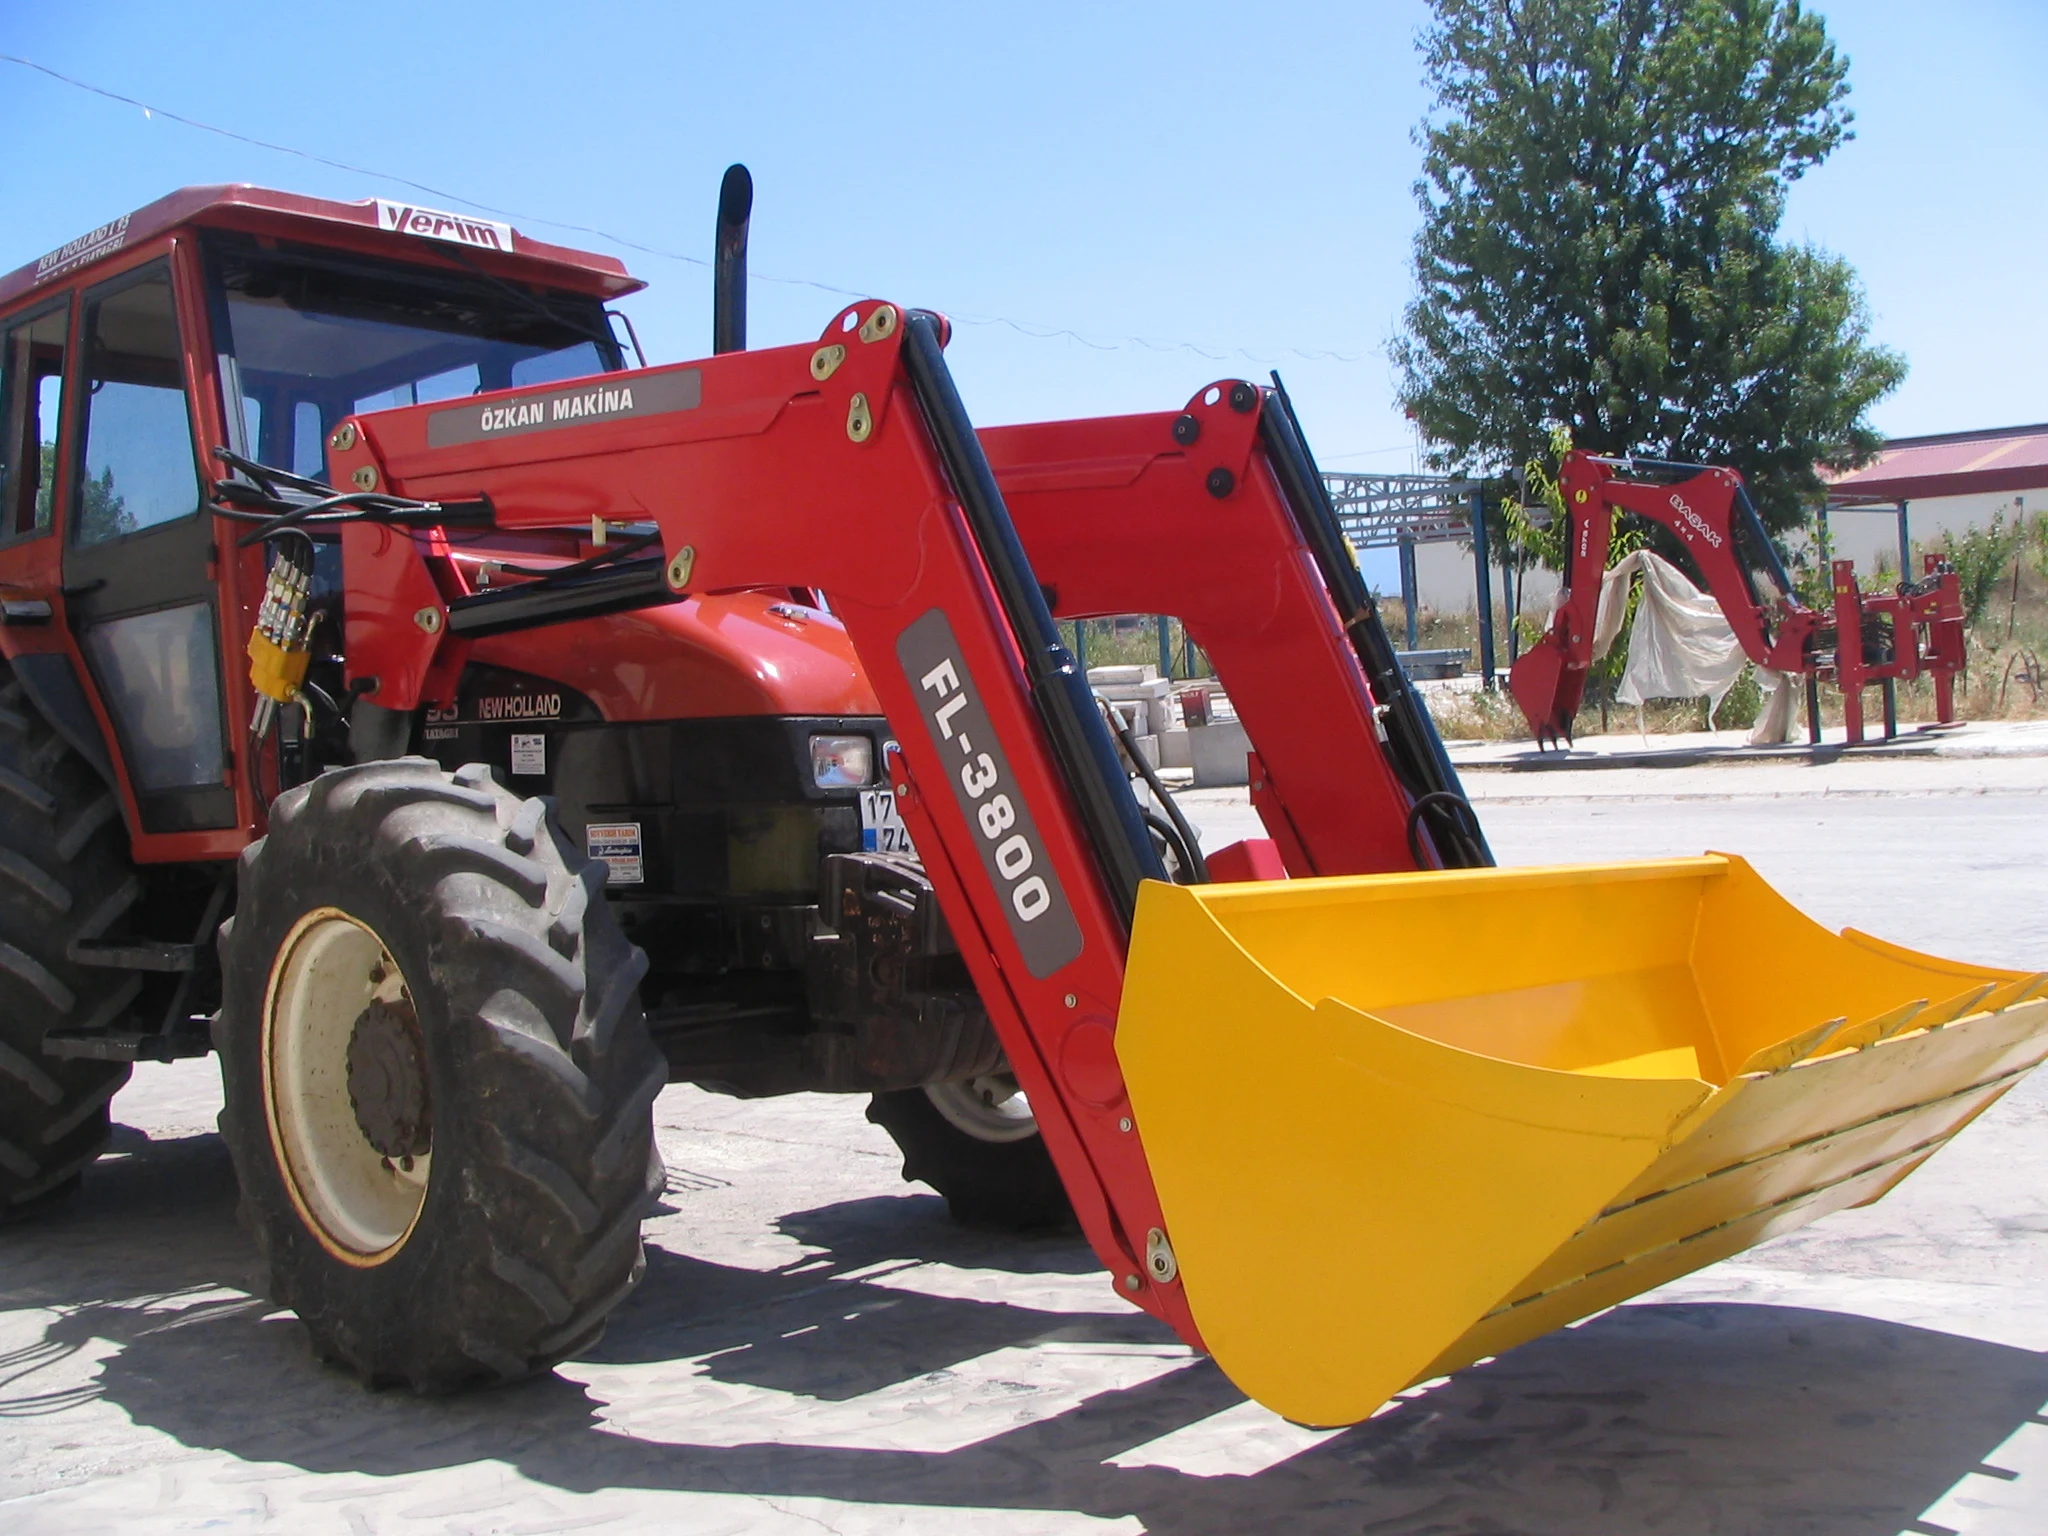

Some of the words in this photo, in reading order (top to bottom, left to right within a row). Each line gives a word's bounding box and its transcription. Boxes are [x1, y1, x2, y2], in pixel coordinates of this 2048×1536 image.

[60, 227, 108, 261] HOLLAND
[387, 206, 501, 250] Verim
[481, 402, 544, 431] ÖZKAN
[553, 387, 634, 421] MAKİNA
[504, 694, 561, 718] HOLLAND
[867, 794, 892, 824] 17
[921, 658, 1051, 922] FL-3800
